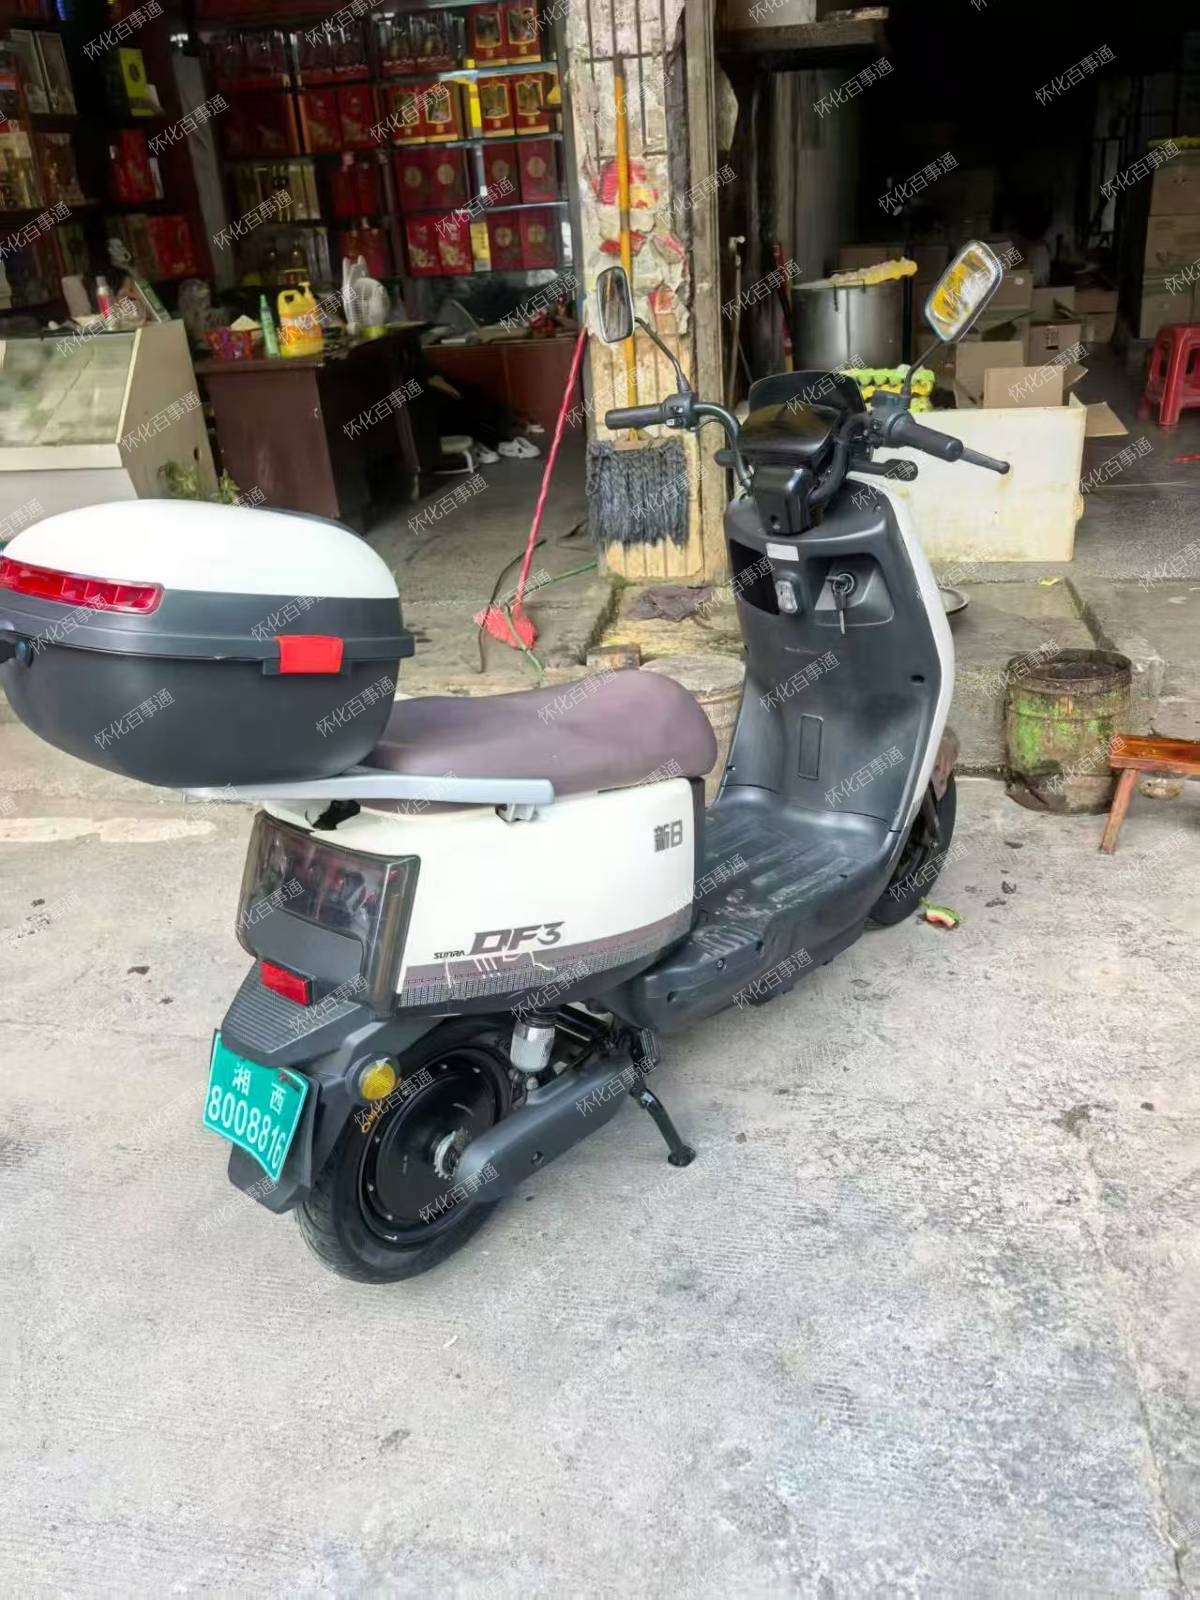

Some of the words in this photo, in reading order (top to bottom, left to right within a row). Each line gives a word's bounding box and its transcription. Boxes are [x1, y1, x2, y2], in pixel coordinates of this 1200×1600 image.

[653, 819, 683, 852] 新日
[467, 921, 565, 956] DF3
[232, 1063, 252, 1096] 湘
[269, 1082, 287, 1114] 西
[208, 1085, 286, 1168] 8008816
